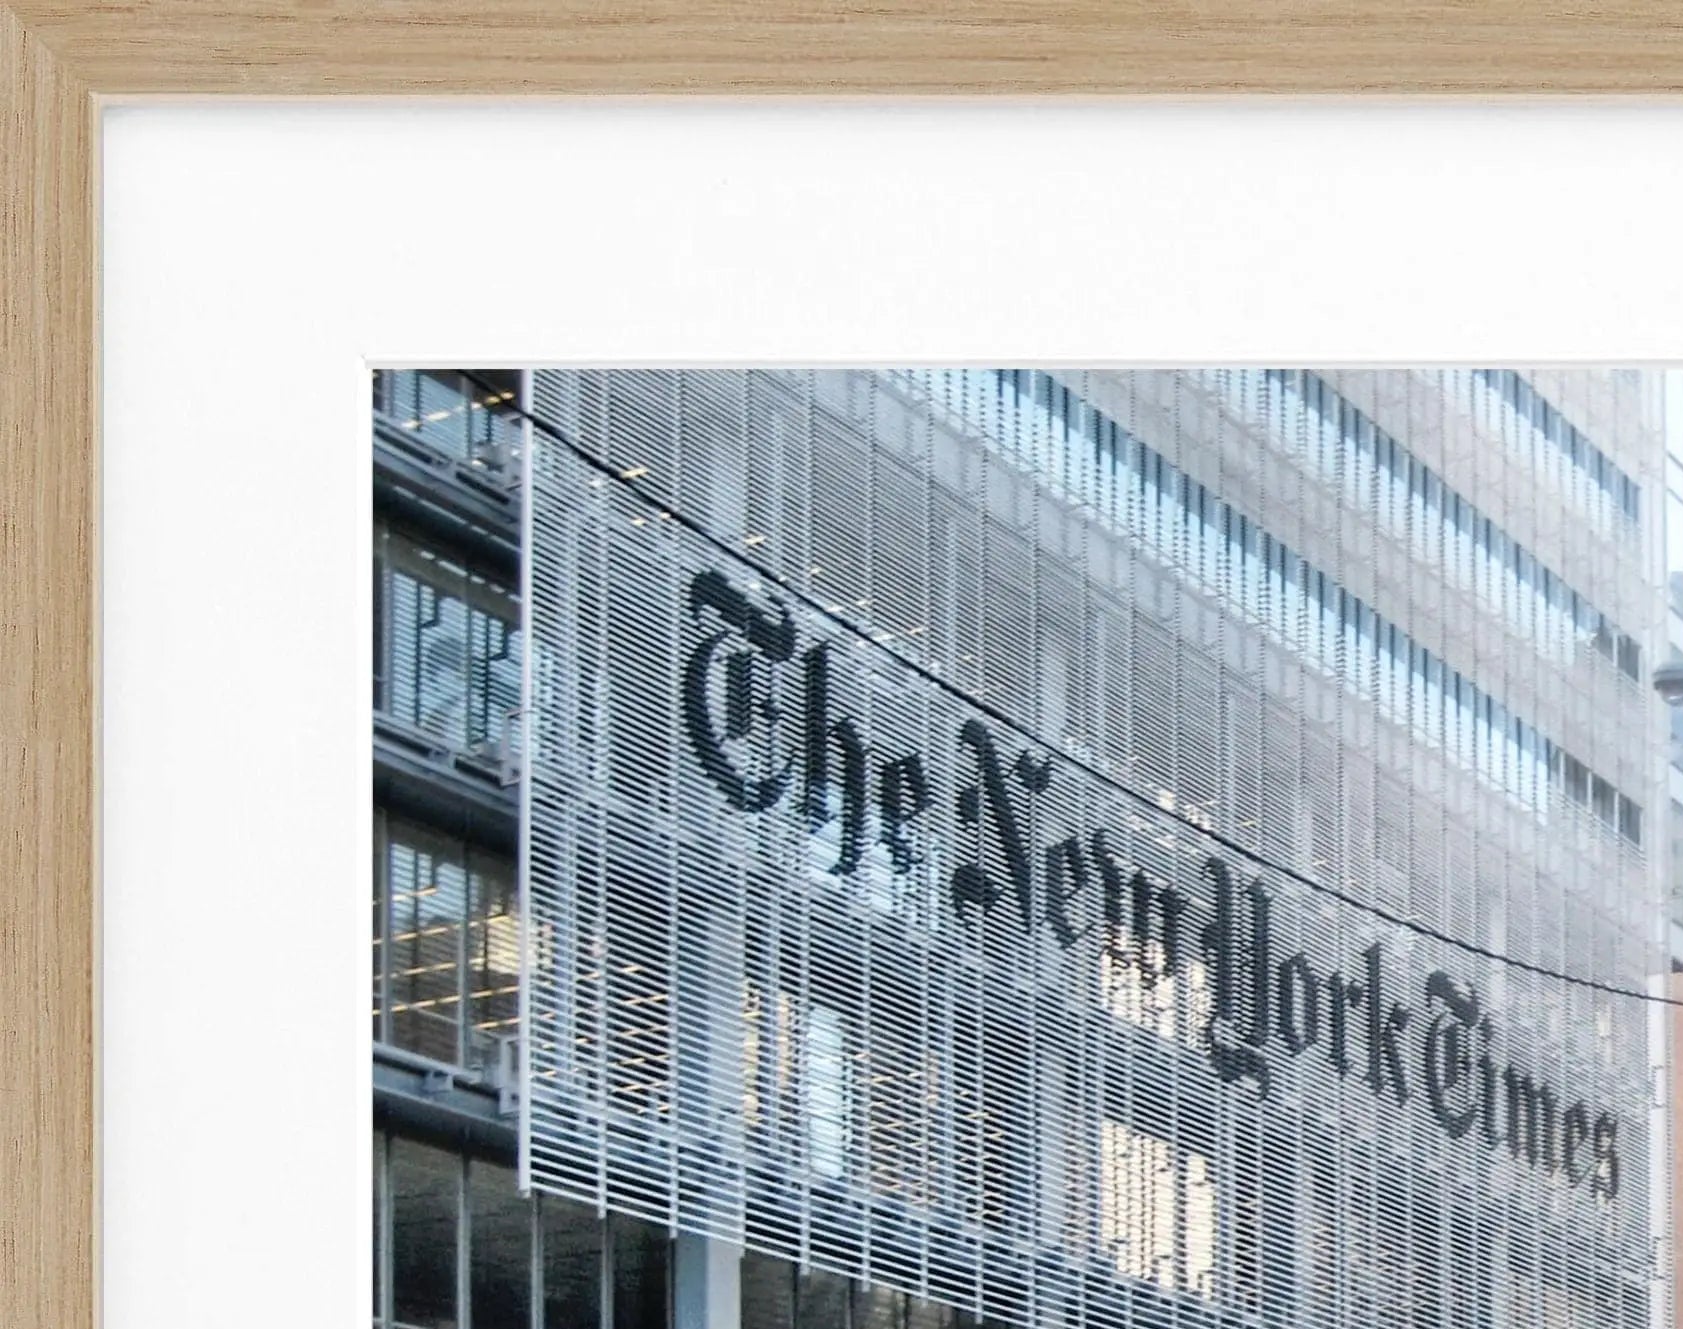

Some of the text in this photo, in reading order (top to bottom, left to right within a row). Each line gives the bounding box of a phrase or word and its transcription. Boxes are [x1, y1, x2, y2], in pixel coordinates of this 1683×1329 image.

[682, 570, 1621, 1199] The New York Times
